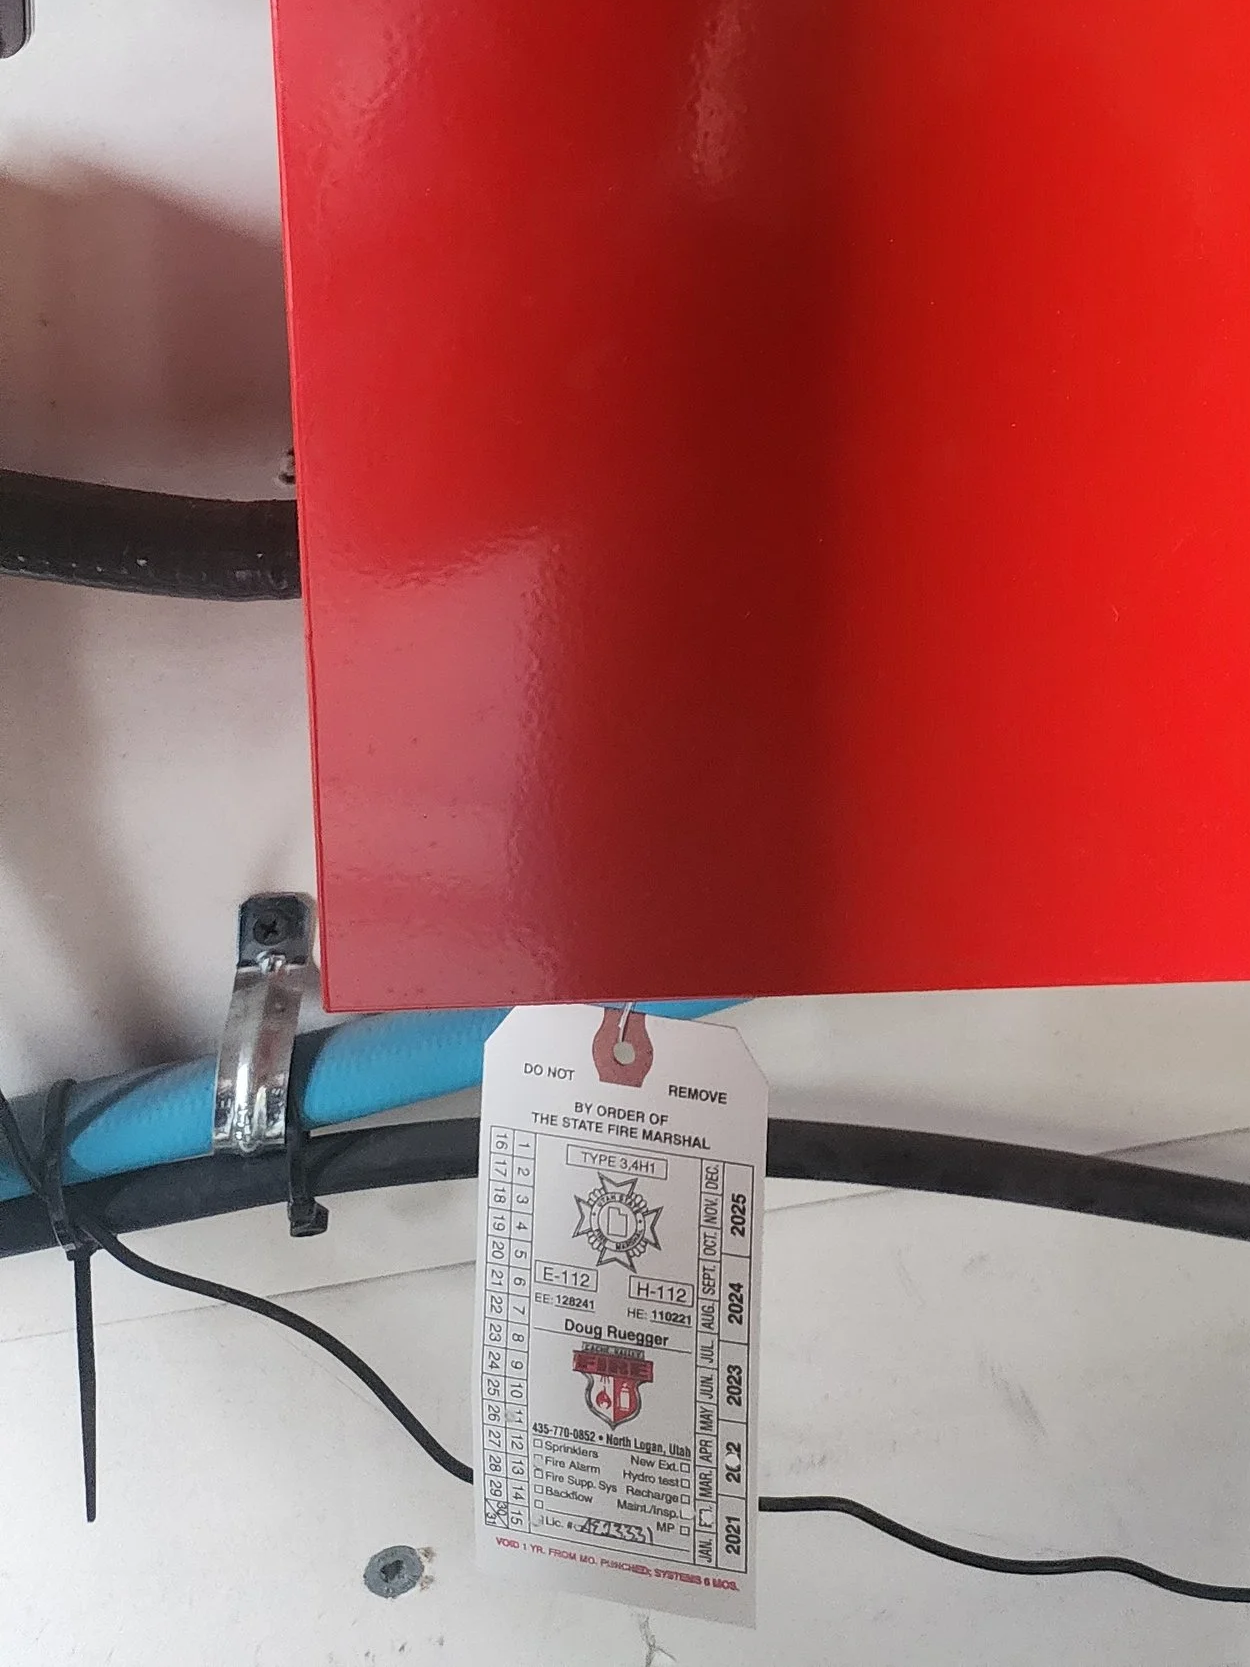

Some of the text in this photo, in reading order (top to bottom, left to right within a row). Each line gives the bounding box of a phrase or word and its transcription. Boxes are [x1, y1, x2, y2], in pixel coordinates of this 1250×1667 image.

[523, 1062, 575, 1081] DO NOT
[667, 1084, 728, 1105] REMOVE
[574, 1101, 668, 1126] BY ORDER OF
[531, 1111, 711, 1150] THE STATE FIRE MARSHAL
[495, 1134, 509, 1150] 16
[494, 1159, 507, 1177] 17
[518, 1166, 530, 1177] 2
[581, 1150, 656, 1175] TYPE 3,4H1
[705, 1164, 720, 1190] DEC.
[493, 1187, 507, 1205] 18
[516, 1194, 529, 1205] 3
[704, 1197, 719, 1225] NOV.
[730, 1193, 748, 1238] 2025
[492, 1215, 506, 1232] 19
[515, 1221, 528, 1231] 4
[491, 1240, 505, 1260] 20
[703, 1232, 718, 1256] OCT.
[514, 1248, 527, 1260] 5
[491, 1269, 504, 1287] 21
[513, 1276, 526, 1287] 6
[543, 1266, 590, 1288] E-112
[702, 1265, 716, 1296] SEPT.
[534, 1292, 595, 1310] EE: 128241
[636, 1281, 687, 1303] H-112
[490, 1295, 503, 1314] 22
[513, 1305, 526, 1315] 7
[728, 1282, 745, 1326] 2024
[627, 1307, 692, 1326] HE: 110221
[701, 1302, 716, 1331] AUG.
[489, 1323, 502, 1343] 23
[512, 1332, 525, 1343] 8
[564, 1318, 669, 1348] Doug Ruegger
[488, 1350, 501, 1370] 24
[511, 1360, 524, 1370] 9
[487, 1378, 500, 1397] 25
[510, 1383, 523, 1399] 10
[699, 1373, 714, 1400] JUN.
[726, 1364, 743, 1407] 2023
[487, 1404, 501, 1423] 26
[700, 1407, 714, 1432] MAY
[488, 1429, 501, 1448] 27
[511, 1434, 524, 1451] 12
[532, 1422, 692, 1458] 435-770-0852 North Logan, Utah
[544, 1440, 599, 1459] Sprinklers
[699, 1439, 713, 1463] APR
[489, 1454, 502, 1473] 28
[511, 1460, 525, 1476] 13
[544, 1456, 601, 1475] Fire Alarm
[630, 1454, 656, 1468] New
[545, 1471, 618, 1494] Fire Supp. Sys
[622, 1469, 680, 1488] Hydro test
[699, 1470, 713, 1498] MAR.
[489, 1479, 503, 1498] 29
[512, 1485, 525, 1501] 14
[545, 1486, 594, 1504] Backflow
[625, 1484, 679, 1505] Recharge
[510, 1510, 523, 1526] 15
[545, 1516, 564, 1529] Lic.
[656, 1521, 675, 1534] MP
[725, 1515, 741, 1556] 2021
[530, 1543, 546, 1555] YR.
[548, 1547, 577, 1561] FROM
[698, 1538, 713, 1563] JAN.
